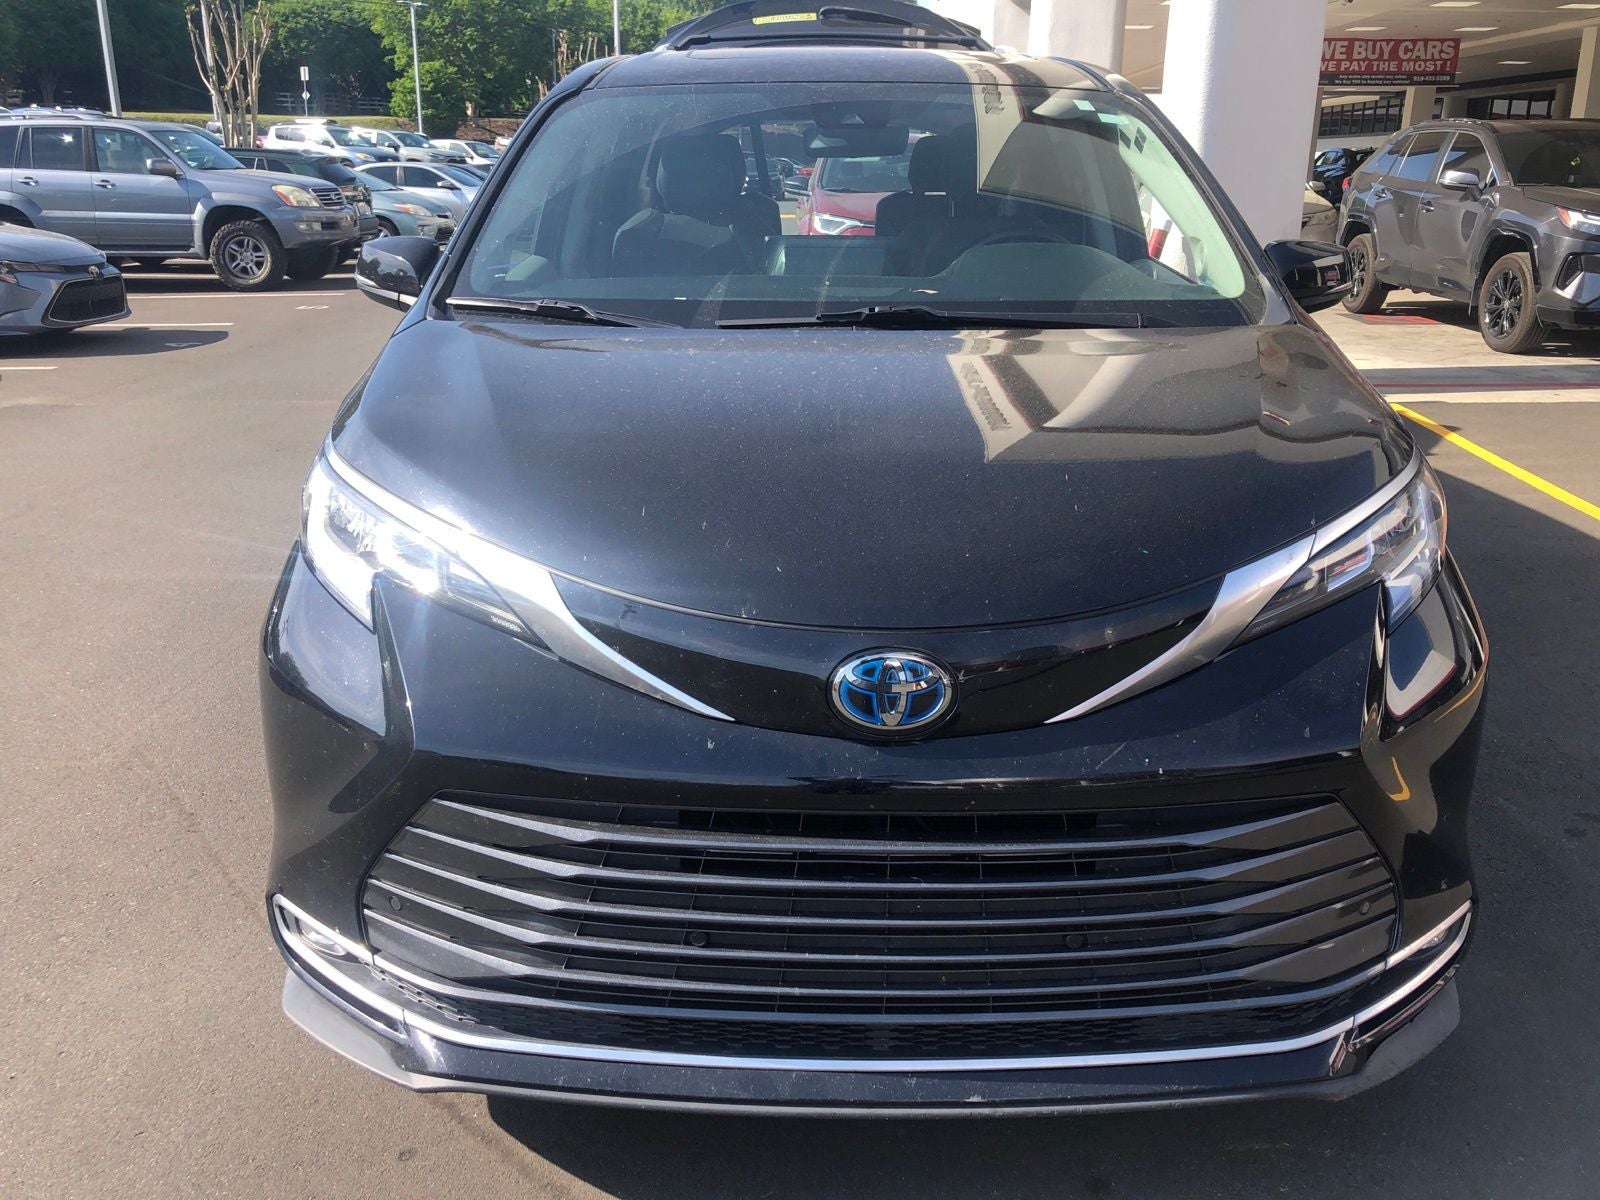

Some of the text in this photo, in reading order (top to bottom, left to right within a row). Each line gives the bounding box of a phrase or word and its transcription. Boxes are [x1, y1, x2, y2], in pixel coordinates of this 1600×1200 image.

[1352, 40, 1396, 60] BUY
[1398, 40, 1455, 60] CARS
[1340, 61, 1369, 71] PAY
[1372, 61, 1398, 71] THE
[1402, 61, 1444, 71] MOST
